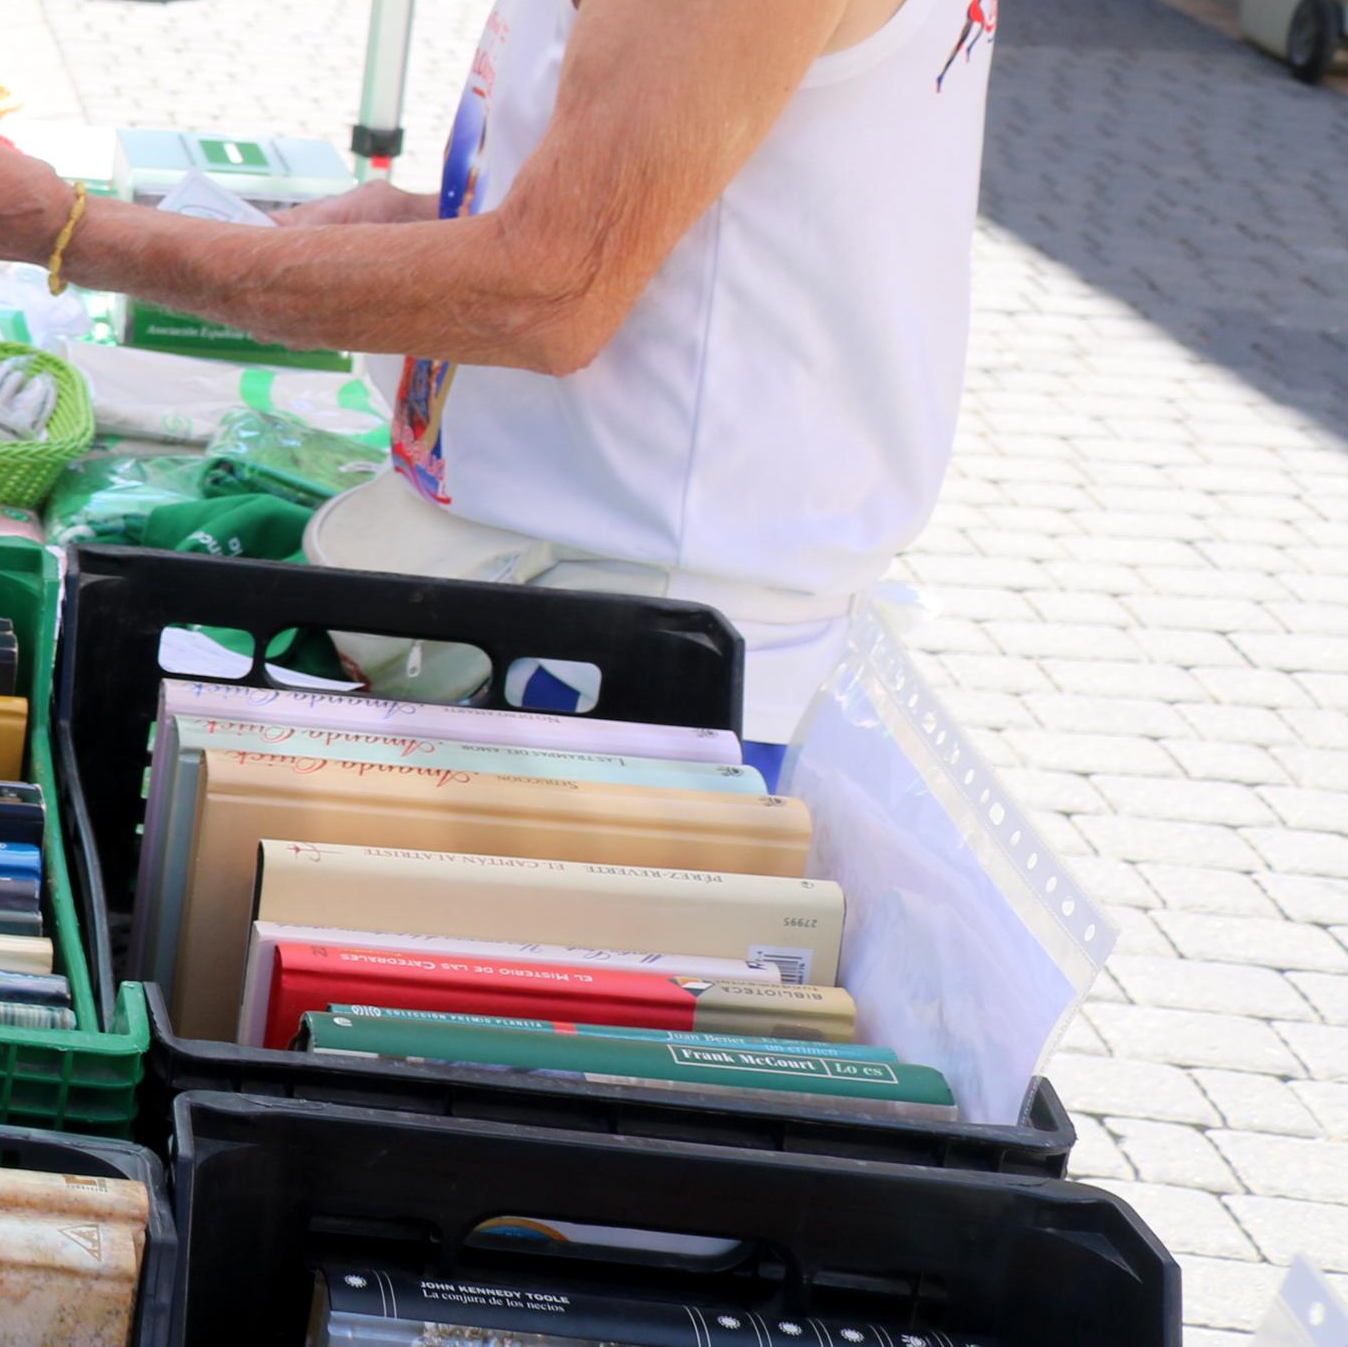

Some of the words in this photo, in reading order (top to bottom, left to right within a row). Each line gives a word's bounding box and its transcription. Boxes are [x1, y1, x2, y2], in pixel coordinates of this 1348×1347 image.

[185, 682, 279, 705] Quick
[293, 693, 416, 719] Amanda
[195, 719, 296, 744] Quick
[305, 728, 437, 757] Amanda
[226, 749, 329, 774] Quick
[341, 760, 471, 788] Amanda
[363, 847, 457, 863] ALATRISTE
[462, 855, 540, 869] CAPITÁN
[548, 861, 565, 870] EL
[584, 864, 724, 884] PÉREZ-REVERTE
[783, 916, 818, 928] 27995
[339, 952, 436, 971] CATEDRALES
[440, 961, 470, 972] LAS
[473, 964, 494, 974] DE
[498, 967, 570, 982] MISTERIO
[574, 973, 593, 983] EL
[720, 984, 823, 1001] BIBLIOTECA
[450, 1014, 493, 1025] PREMIO
[495, 1018, 543, 1029] PLANETA
[666, 1030, 701, 1043] Juan
[786, 1045, 839, 1057] crimen
[680, 1048, 736, 1064] Frank
[739, 1053, 818, 1072] McCourt
[834, 1062, 859, 1076] Lo
[862, 1066, 884, 1078] es
[420, 1280, 456, 1293] JOHN
[458, 1284, 522, 1299] KENNEDY
[524, 1291, 571, 1304] TOOLE
[422, 1288, 439, 1299] La
[441, 1290, 487, 1306] conjura
[488, 1295, 503, 1306] de
[505, 1297, 525, 1308] los
[526, 1300, 566, 1313] necios
